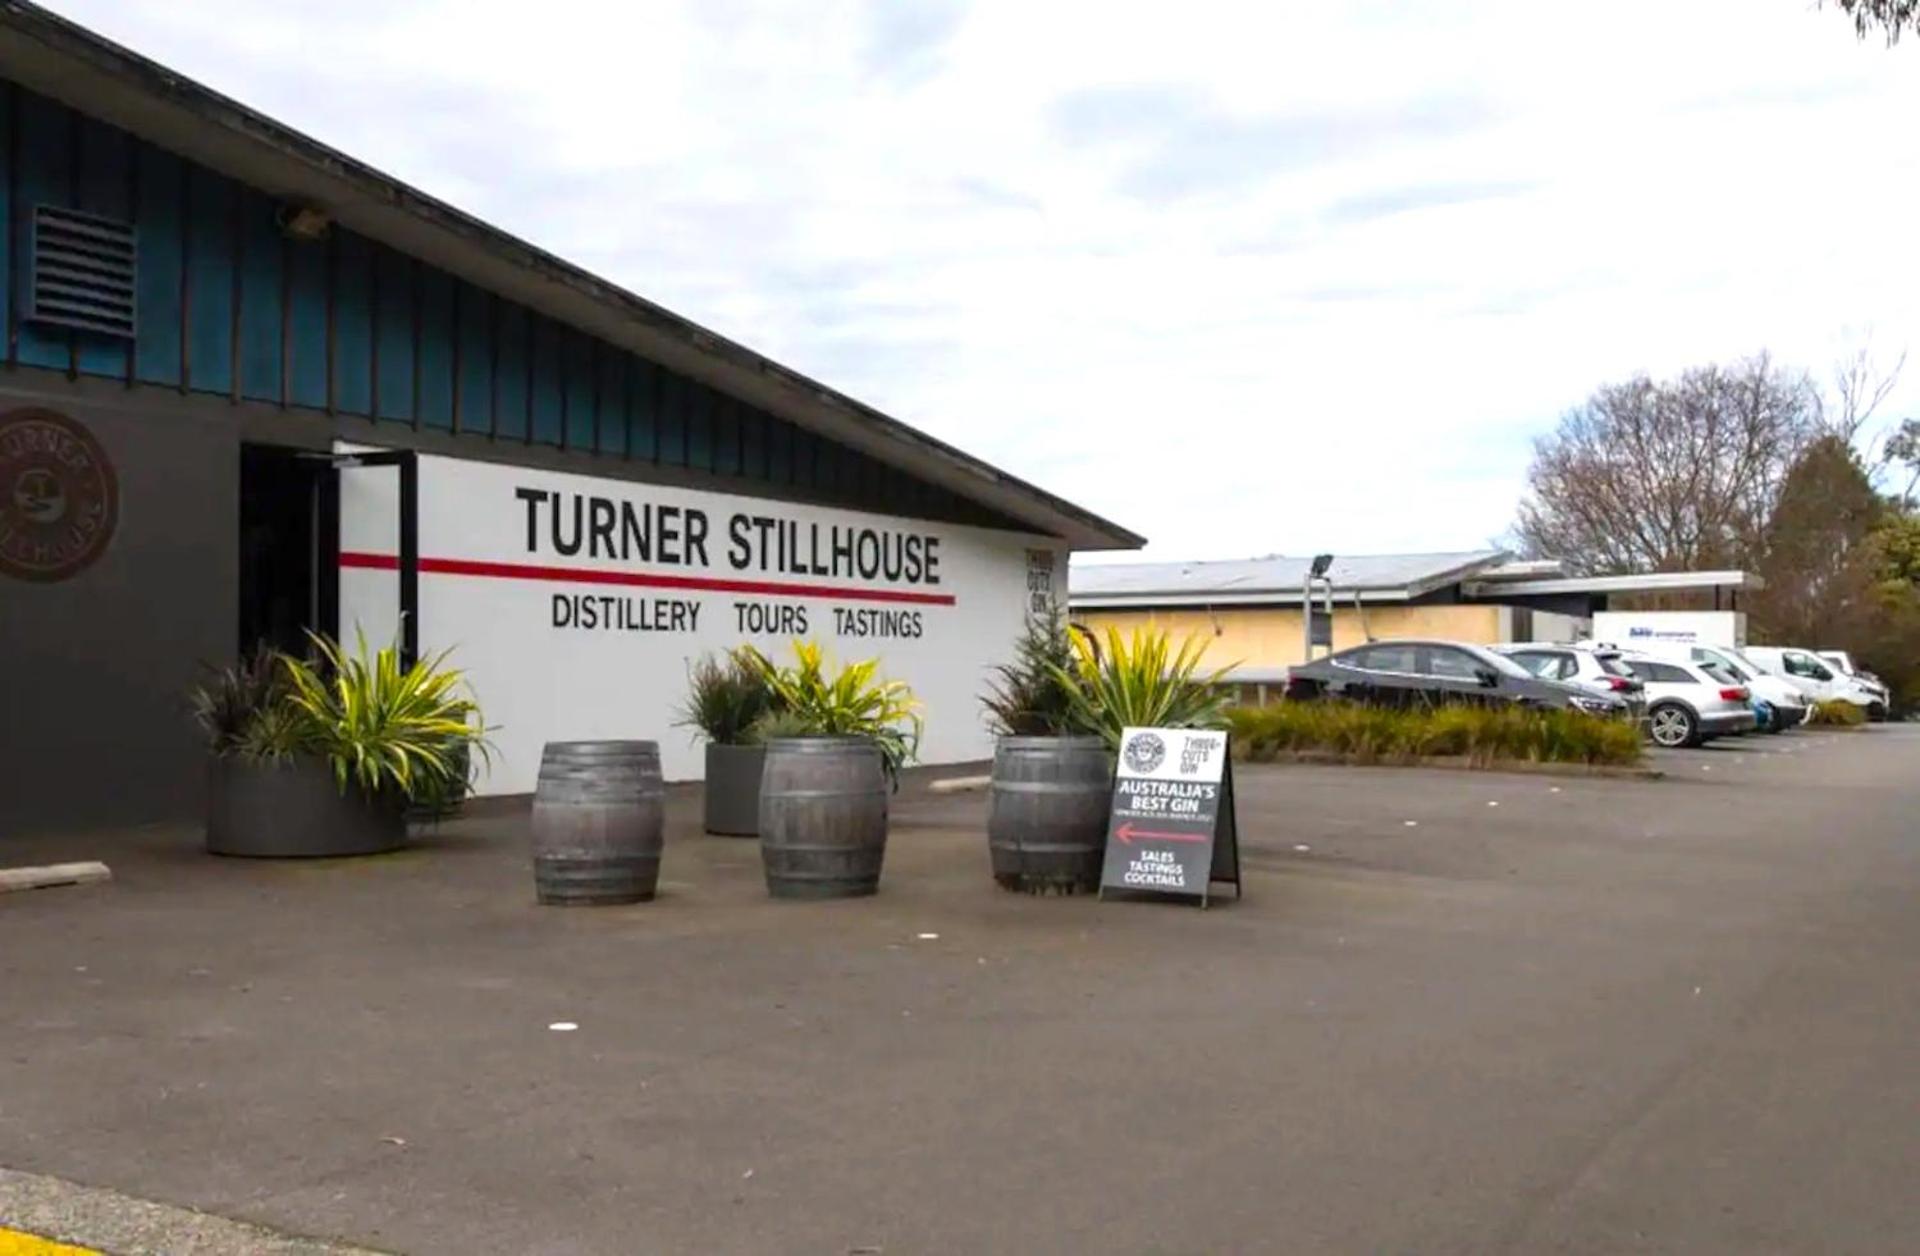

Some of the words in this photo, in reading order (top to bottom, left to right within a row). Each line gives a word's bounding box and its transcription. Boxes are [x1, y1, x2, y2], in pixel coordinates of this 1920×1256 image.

[515, 487, 708, 566] TURNER
[728, 513, 940, 585] STILLHOUSE
[552, 594, 700, 631] DISTILLERY
[734, 604, 807, 634] TOURS
[833, 609, 923, 639] TASTINGS
[1119, 780, 1216, 799] AUSTRALIA'S
[1132, 796, 1170, 811] BEST
[1170, 797, 1199, 812] GIN
[1141, 850, 1174, 863] SALES
[1130, 860, 1183, 874] TASTINGS
[1124, 871, 1185, 887] COCKTAILS
